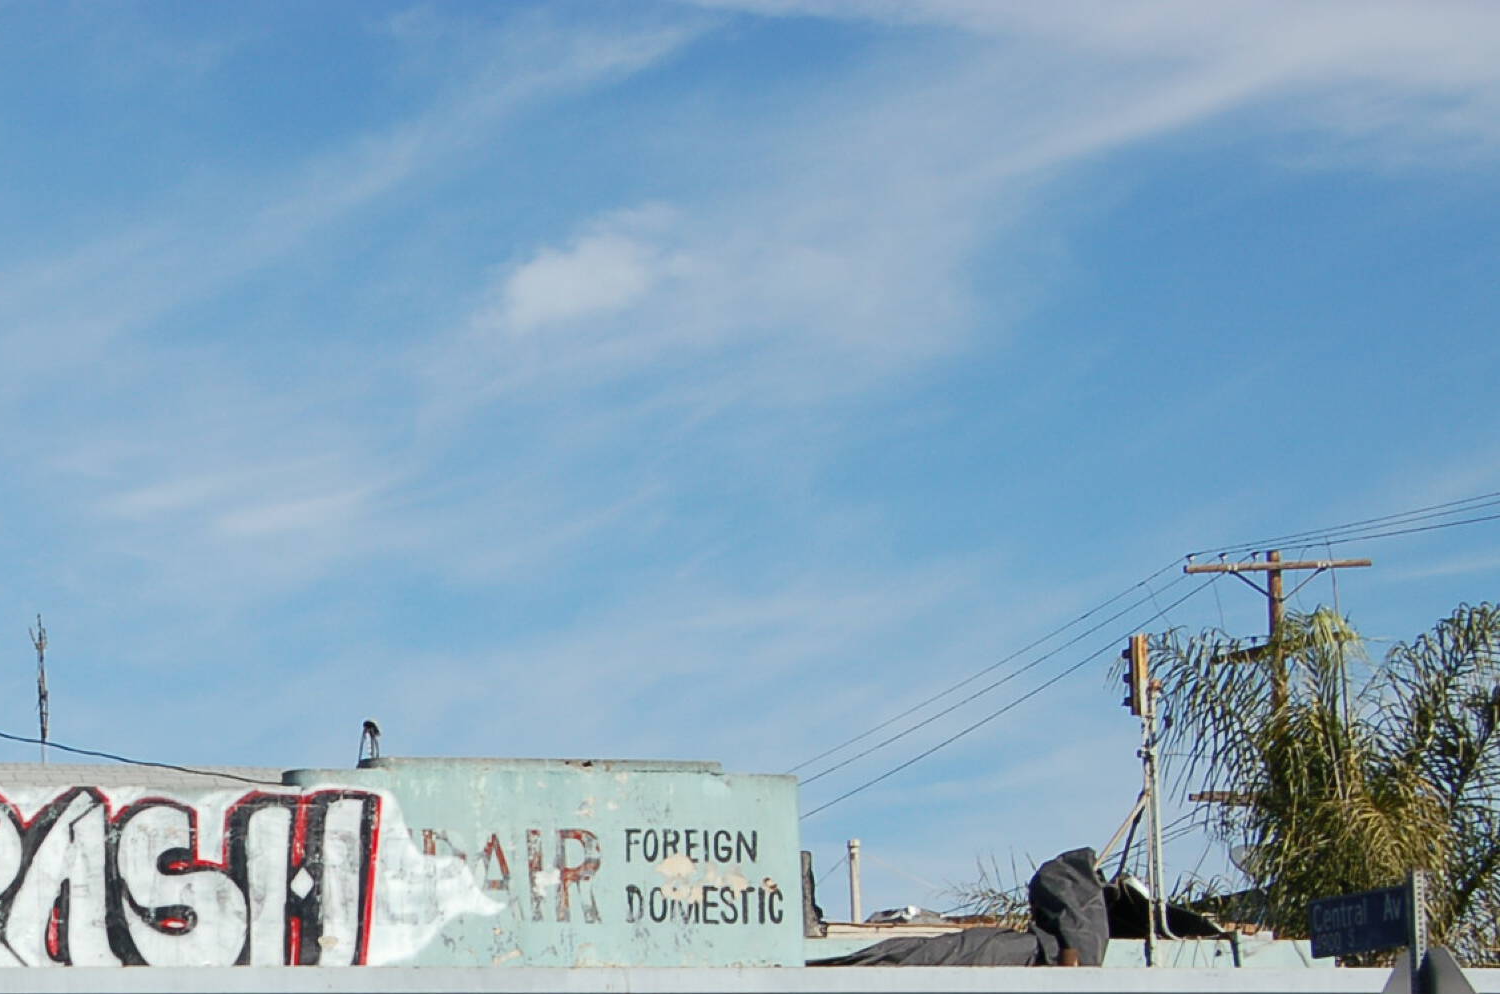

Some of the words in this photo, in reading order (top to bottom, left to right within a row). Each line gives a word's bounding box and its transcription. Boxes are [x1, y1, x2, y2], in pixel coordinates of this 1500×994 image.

[625, 829, 758, 863] FOREIGN
[625, 885, 784, 925] DOMESTIC
[1313, 897, 1368, 933] Central
